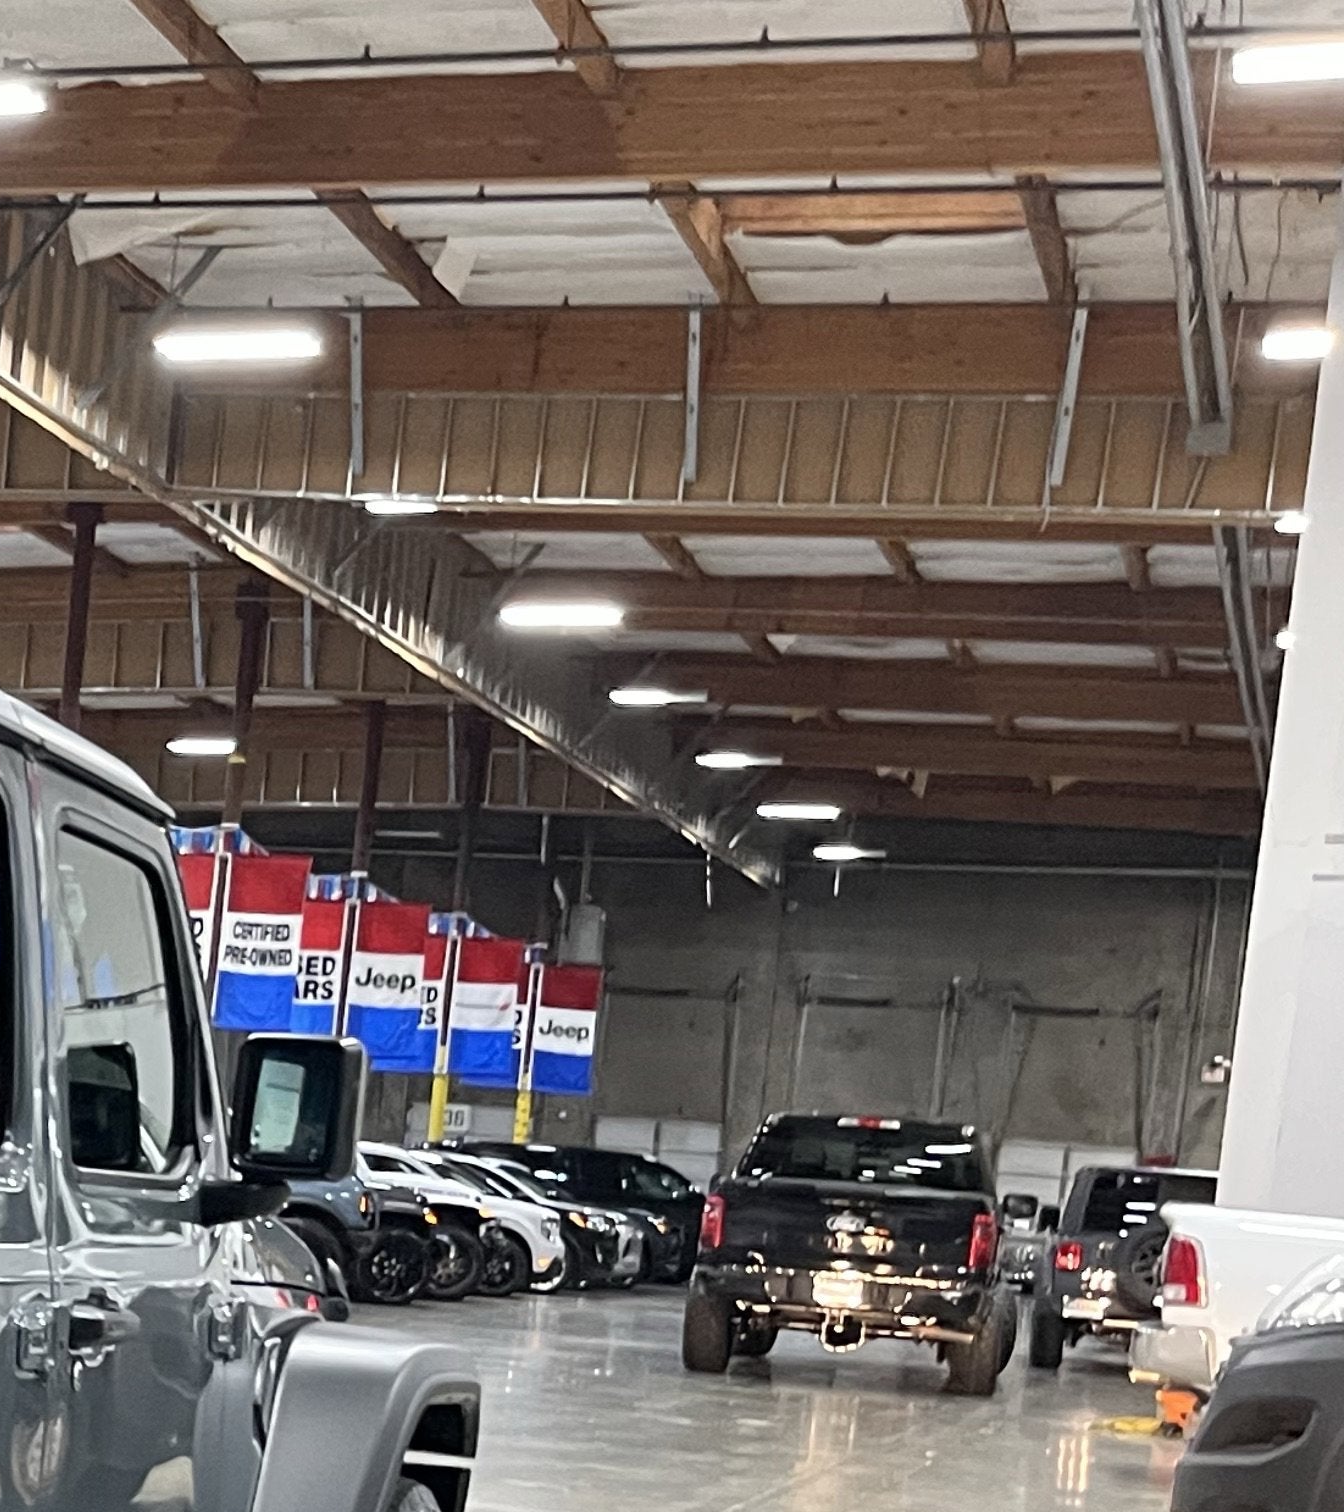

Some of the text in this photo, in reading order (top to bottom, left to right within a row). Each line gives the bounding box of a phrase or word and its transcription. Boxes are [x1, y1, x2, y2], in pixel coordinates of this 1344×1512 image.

[297, 954, 336, 977] ED
[296, 980, 334, 1001] RS
[355, 967, 416, 994] Jeep
[539, 1019, 589, 1042] Jeep
